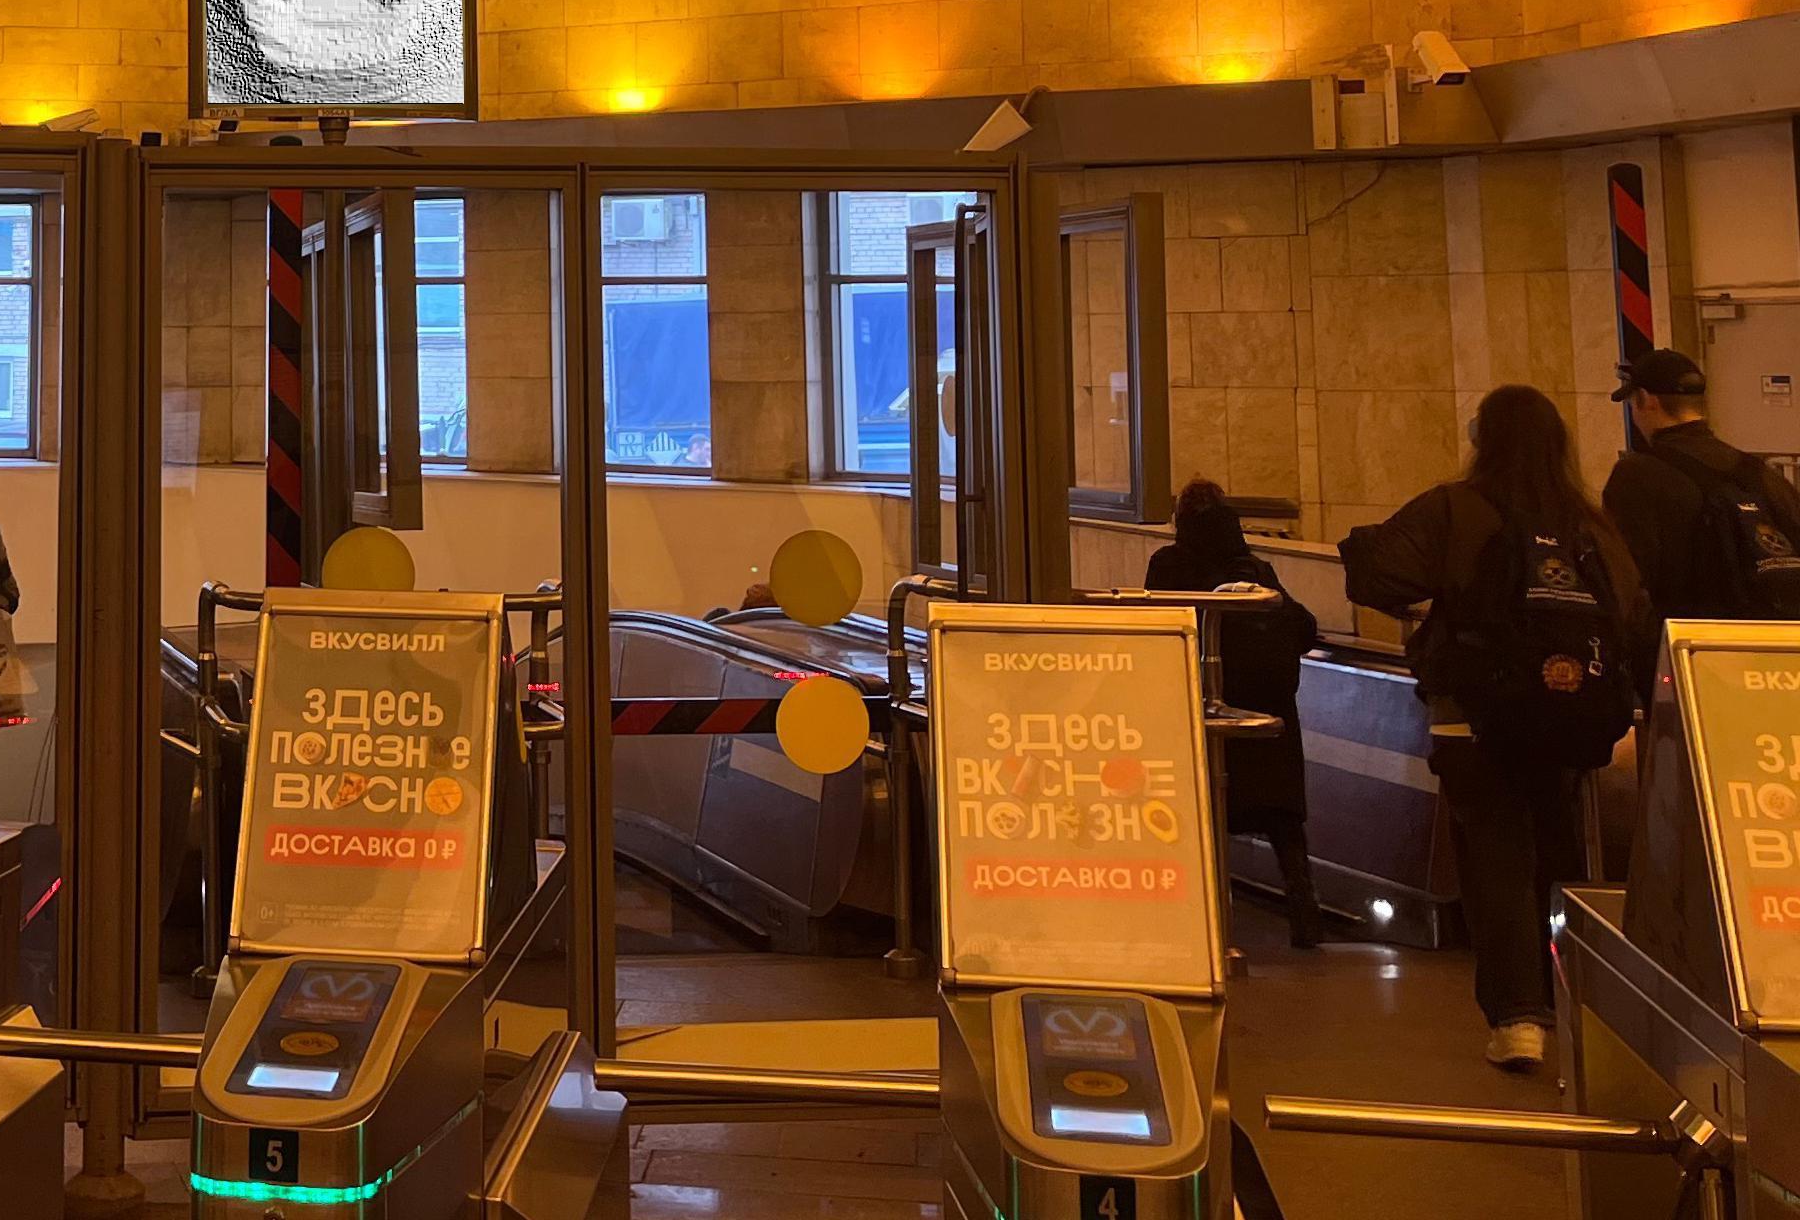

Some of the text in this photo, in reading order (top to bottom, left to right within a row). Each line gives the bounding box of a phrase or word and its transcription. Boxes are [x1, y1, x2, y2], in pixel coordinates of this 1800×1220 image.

[310, 631, 445, 652] ВКУСВИЛЛ
[984, 652, 1133, 672] ВКУСВИЛЛ
[1743, 828, 1800, 869] В
[265, 1140, 284, 1174] 5
[1098, 1187, 1119, 1220] 4
